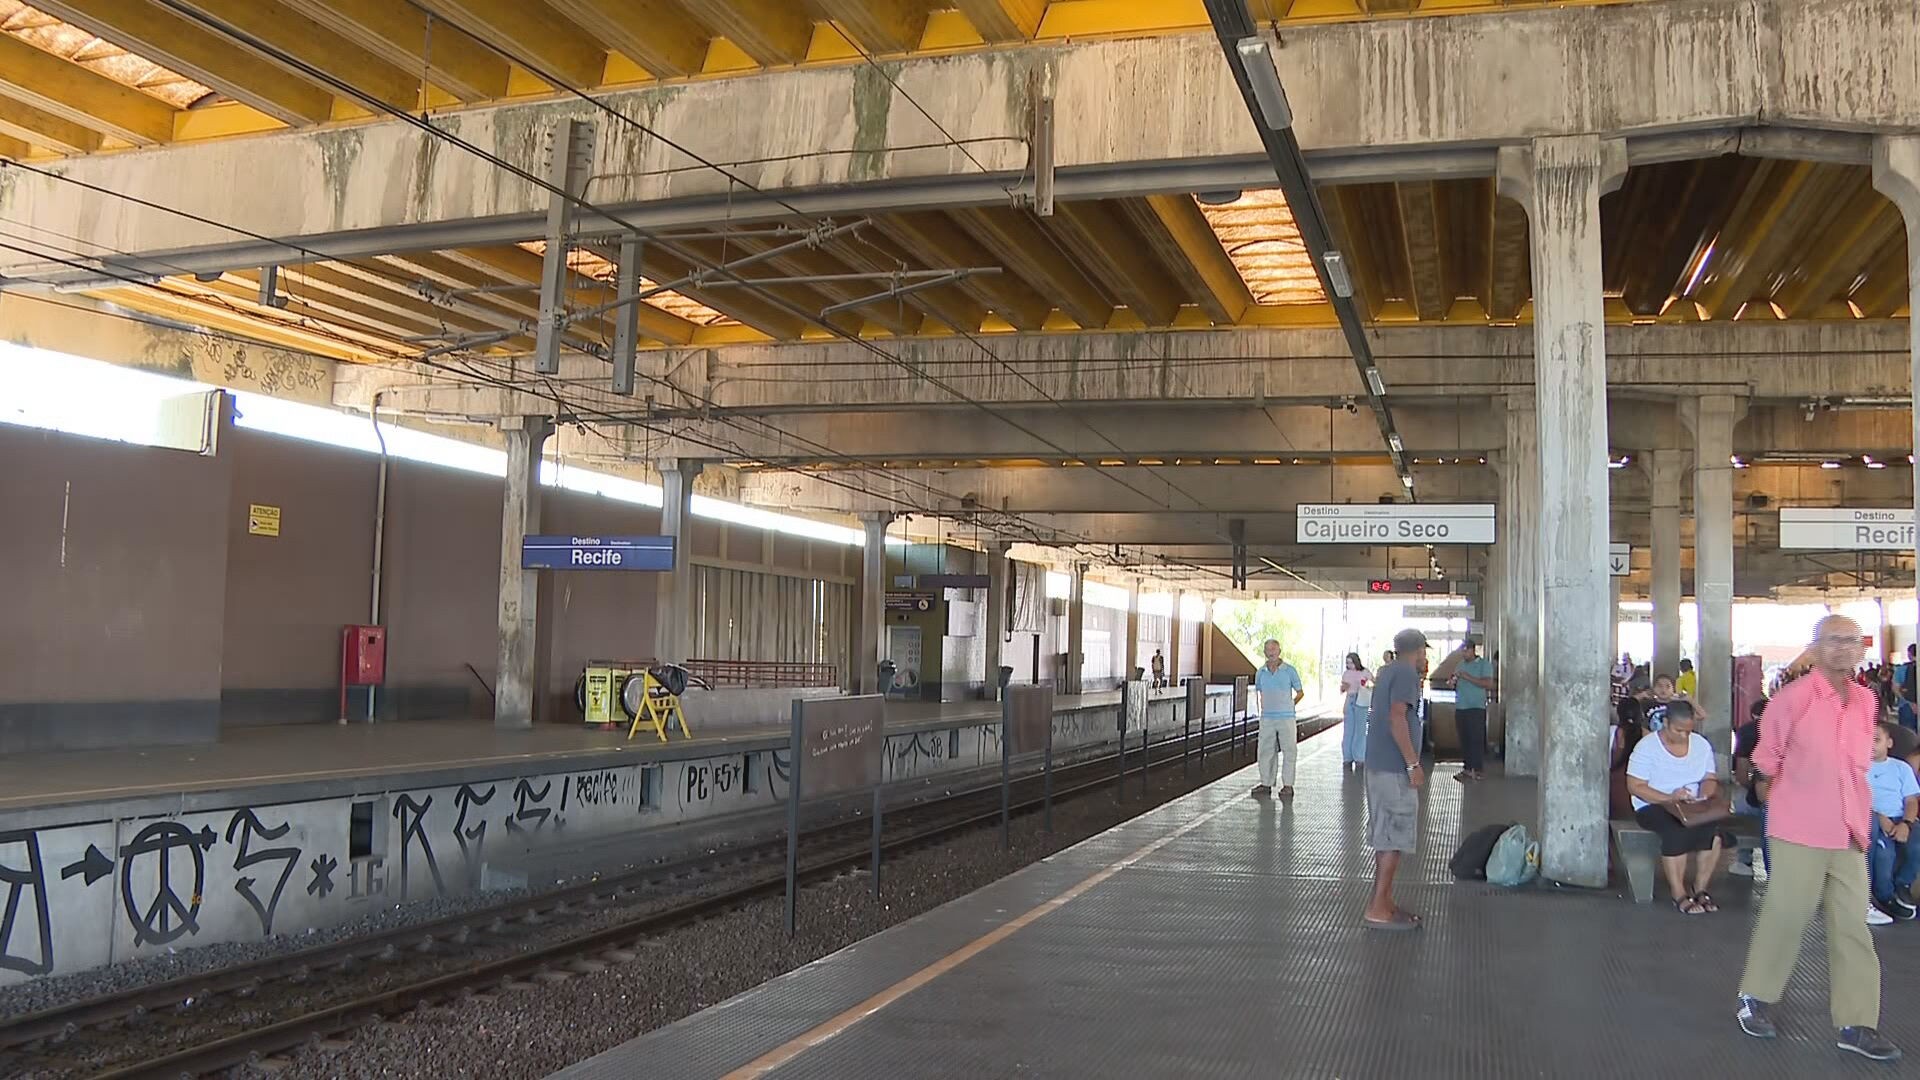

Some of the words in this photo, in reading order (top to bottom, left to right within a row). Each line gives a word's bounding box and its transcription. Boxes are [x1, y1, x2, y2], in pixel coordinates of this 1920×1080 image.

[1304, 507, 1340, 515] Destino
[1854, 511, 1895, 520] Destino
[1304, 520, 1390, 541] Cajueiro
[1398, 520, 1449, 538] Seco
[1855, 526, 1914, 544] Recif
[571, 537, 600, 545] Destino
[571, 550, 622, 565] Recife
